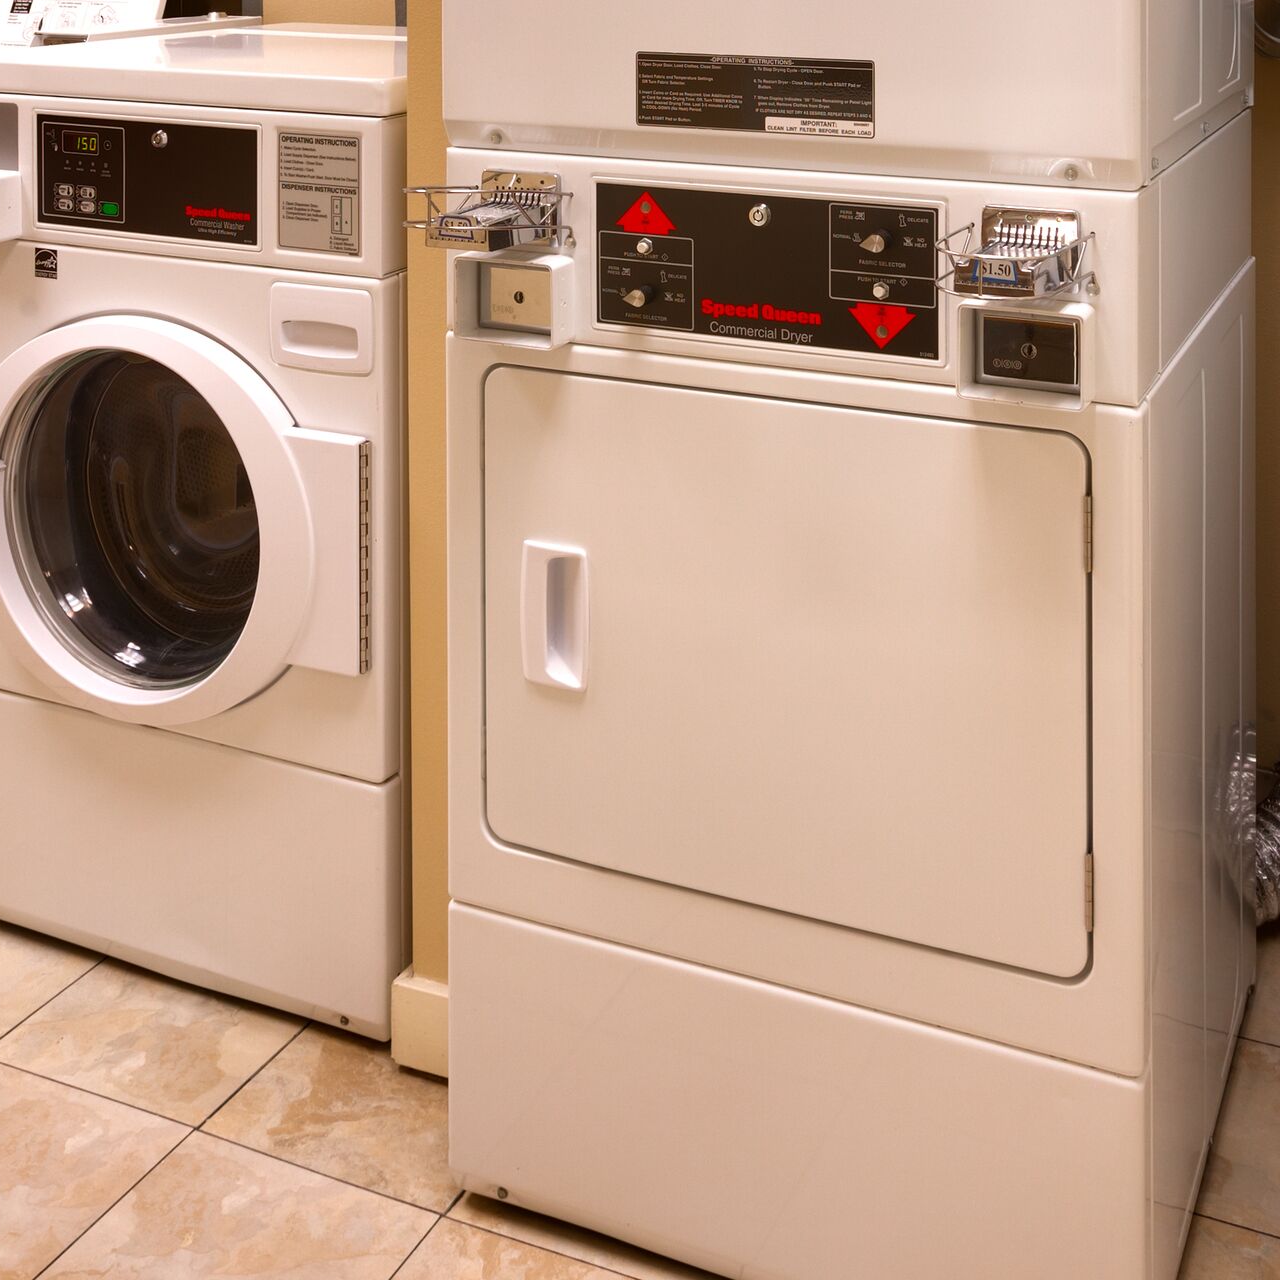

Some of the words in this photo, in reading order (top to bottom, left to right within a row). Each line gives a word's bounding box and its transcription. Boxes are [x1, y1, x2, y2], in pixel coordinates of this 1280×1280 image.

[77, 137, 97, 151] 150
[282, 136, 313, 144] OPERATING
[315, 138, 356, 147] INSTRUCTIONS
[282, 184, 313, 192] DISPENSER
[315, 186, 356, 195] INSTRUCTIONS
[185, 205, 217, 217] Speed
[218, 208, 250, 220] Queen
[190, 218, 222, 228] Commercial
[224, 222, 244, 230] Washer
[982, 261, 1011, 276] $1.50
[701, 299, 759, 319] Speed
[761, 304, 821, 325] Queen
[709, 321, 777, 339] Commercial
[781, 329, 813, 344] Dryer
